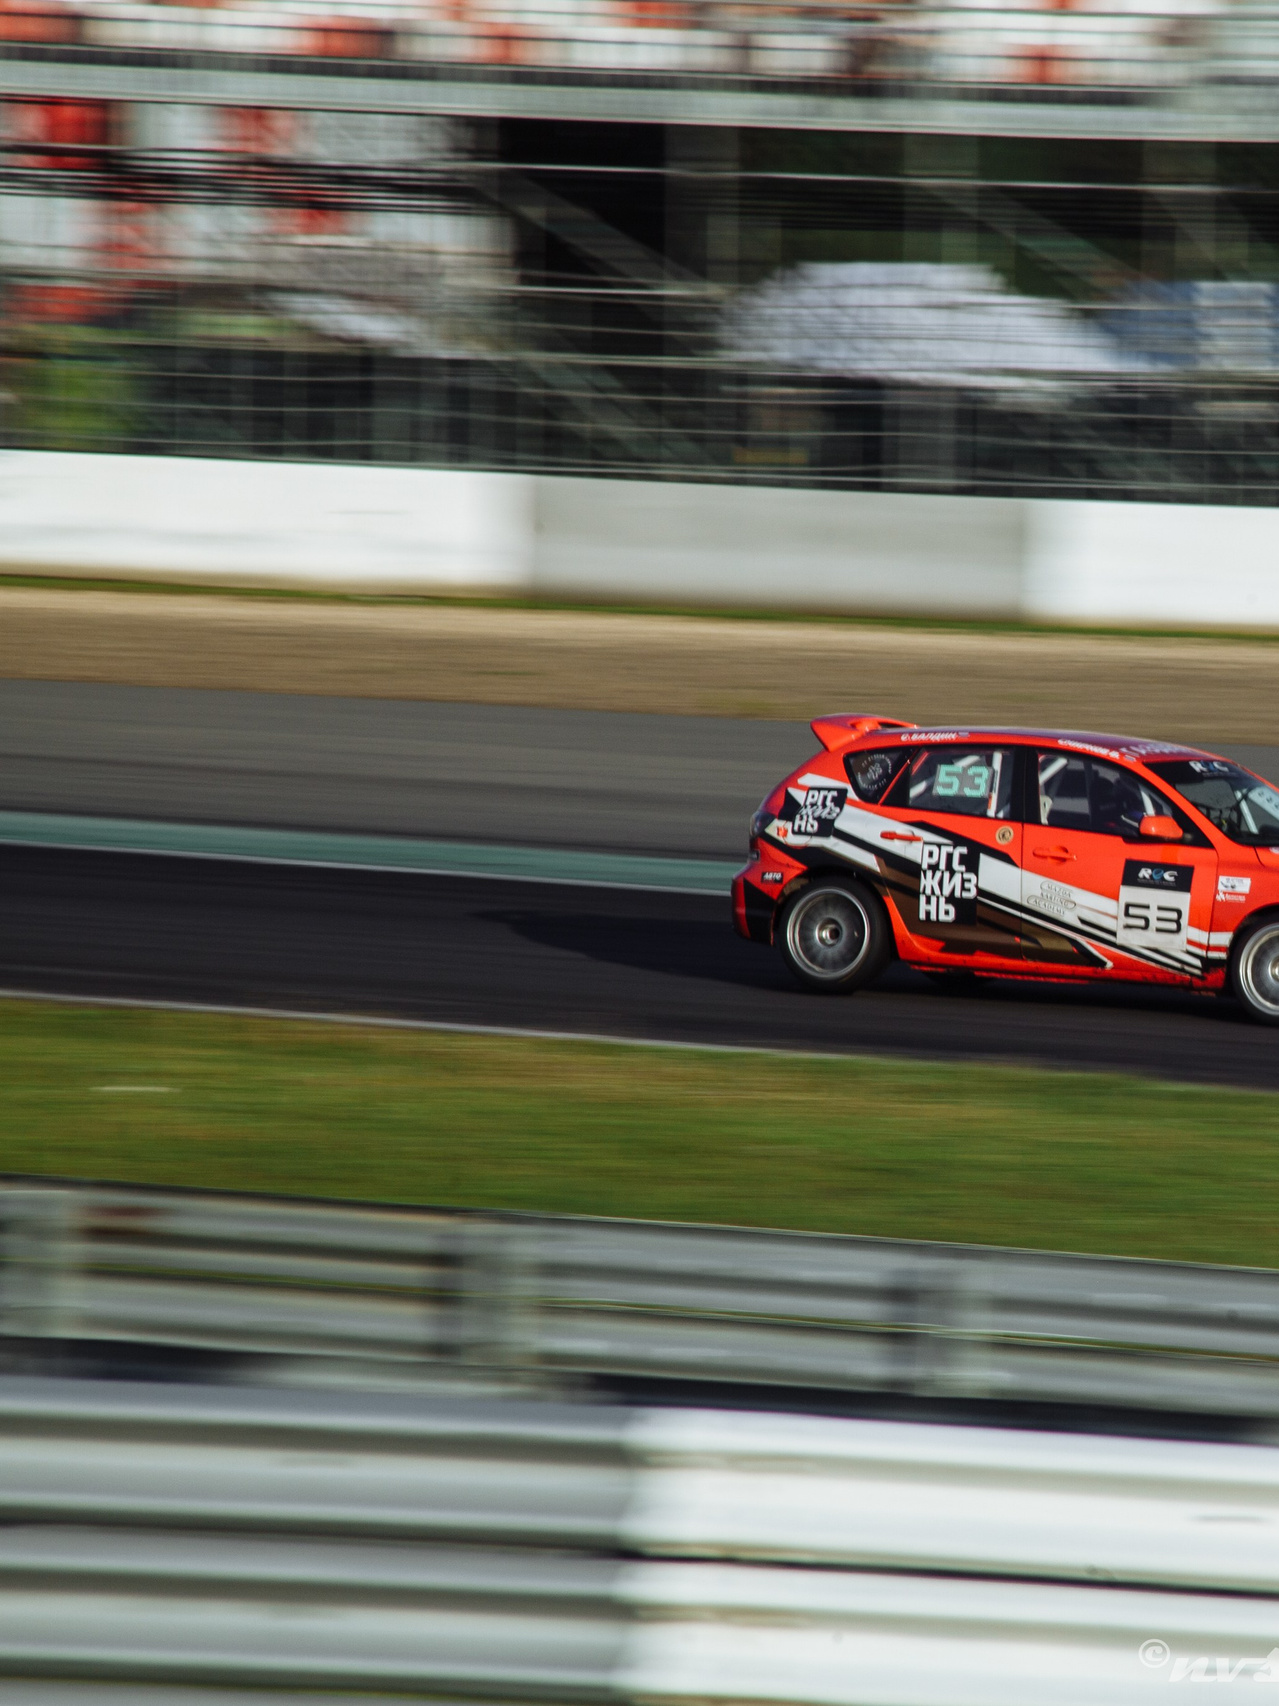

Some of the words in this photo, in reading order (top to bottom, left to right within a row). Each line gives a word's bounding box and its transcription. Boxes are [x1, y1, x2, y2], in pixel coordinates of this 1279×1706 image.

[935, 764, 990, 798] 53
[805, 789, 839, 807] РГС
[793, 813, 819, 834] НЬ
[921, 844, 968, 872] РГС
[919, 870, 978, 899] ЖИЗ
[1047, 883, 1072, 899] MAZDA
[918, 894, 956, 923] НЬ
[1124, 901, 1183, 935] 53
